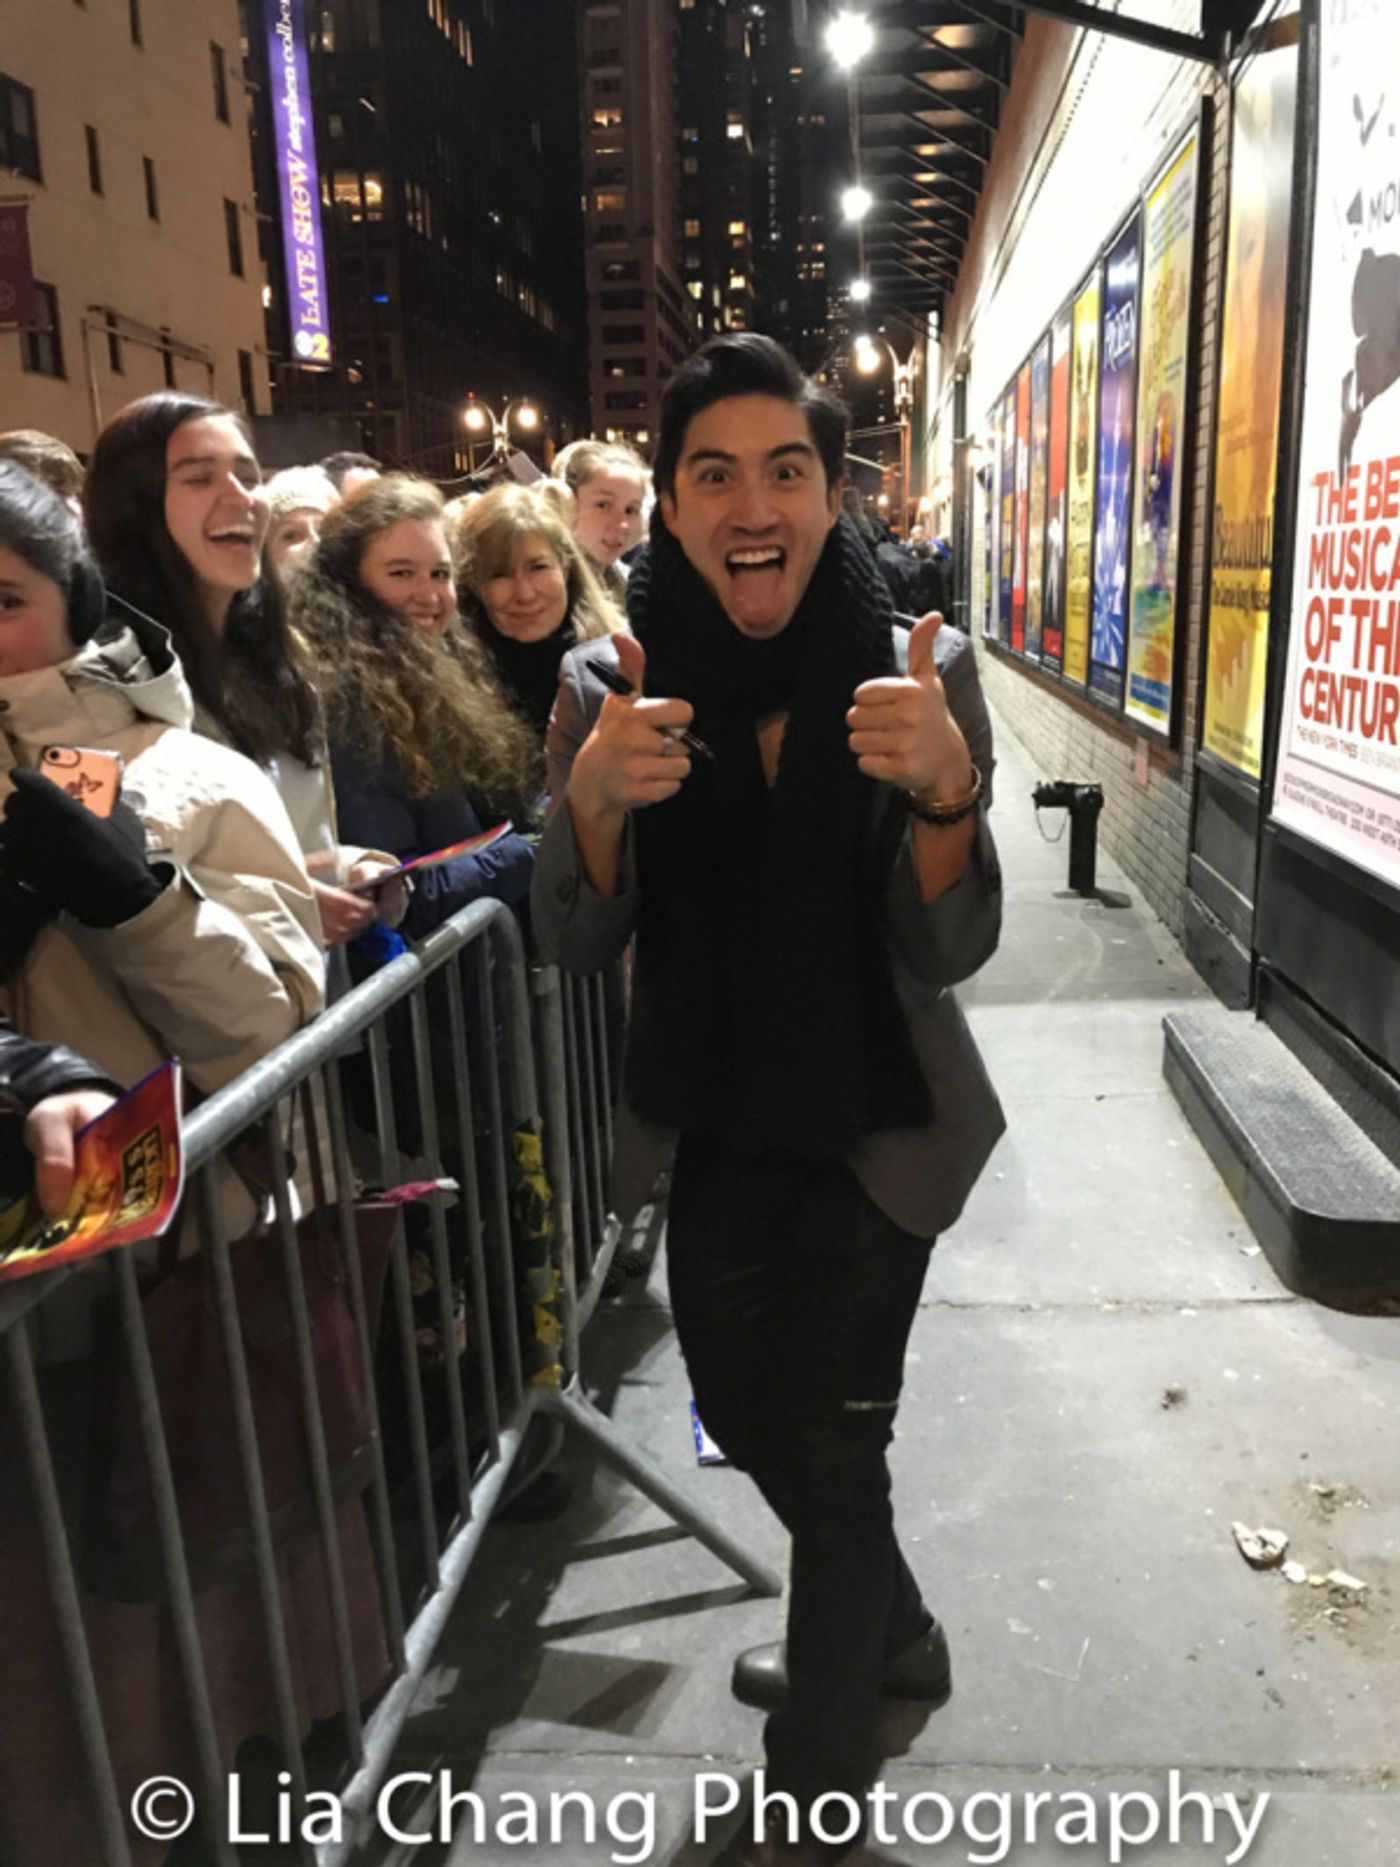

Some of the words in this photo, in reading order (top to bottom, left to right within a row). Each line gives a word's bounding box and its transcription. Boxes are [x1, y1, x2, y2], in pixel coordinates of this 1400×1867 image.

[275, 0, 295, 63] colbe
[287, 148, 314, 246] SHOW
[296, 249, 321, 327] LATE
[1312, 464, 1361, 526] THE
[1304, 595, 1345, 664] OF
[1299, 666, 1400, 746] CENTUR
